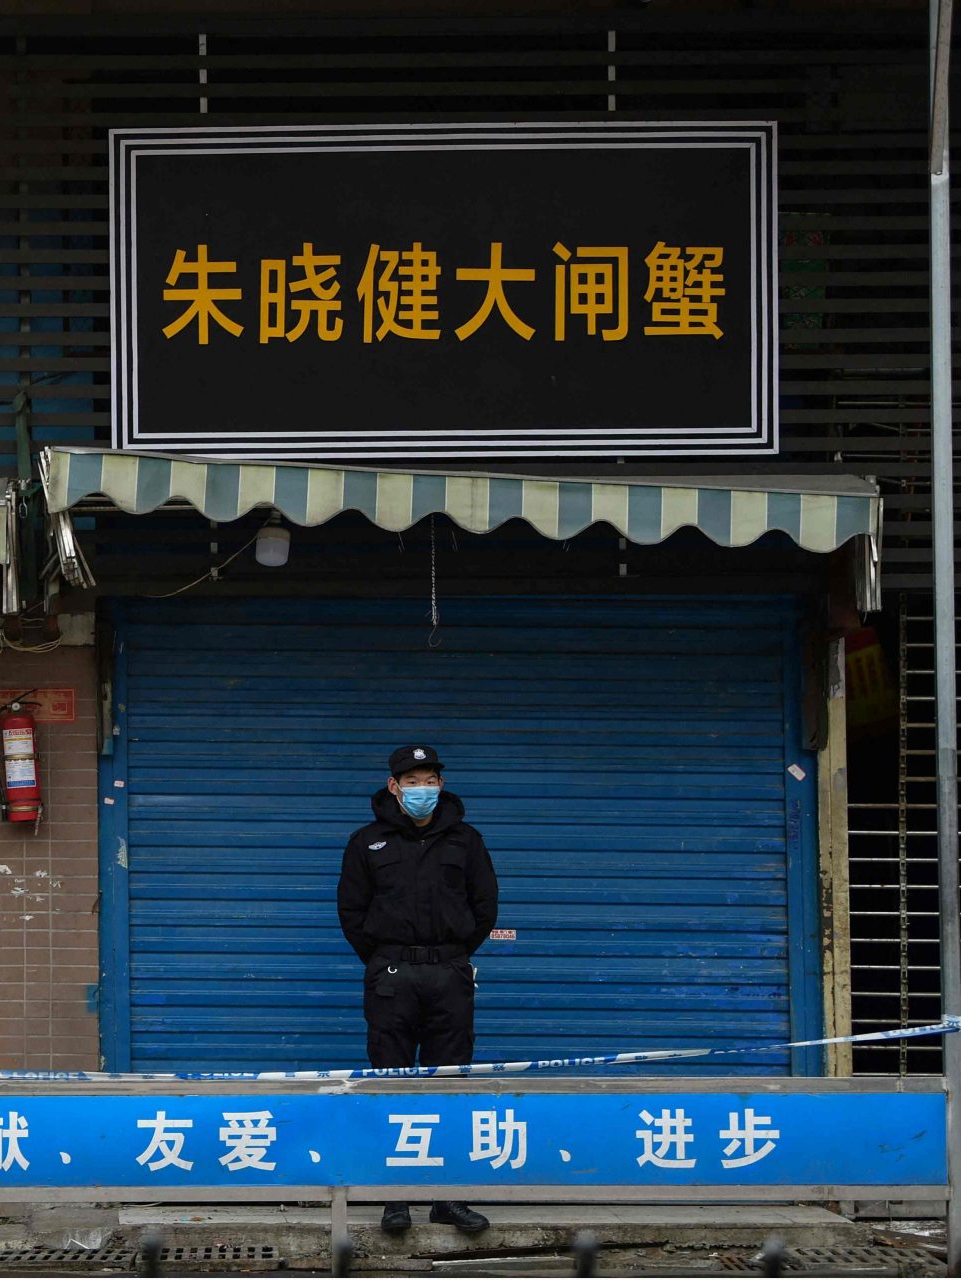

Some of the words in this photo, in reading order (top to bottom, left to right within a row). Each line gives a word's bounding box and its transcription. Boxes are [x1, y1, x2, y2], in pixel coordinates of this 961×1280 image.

[162, 241, 727, 345] 朱晓健大闸蟹
[538, 1056, 606, 1069] POLICE
[362, 1066, 430, 1077] POLICE
